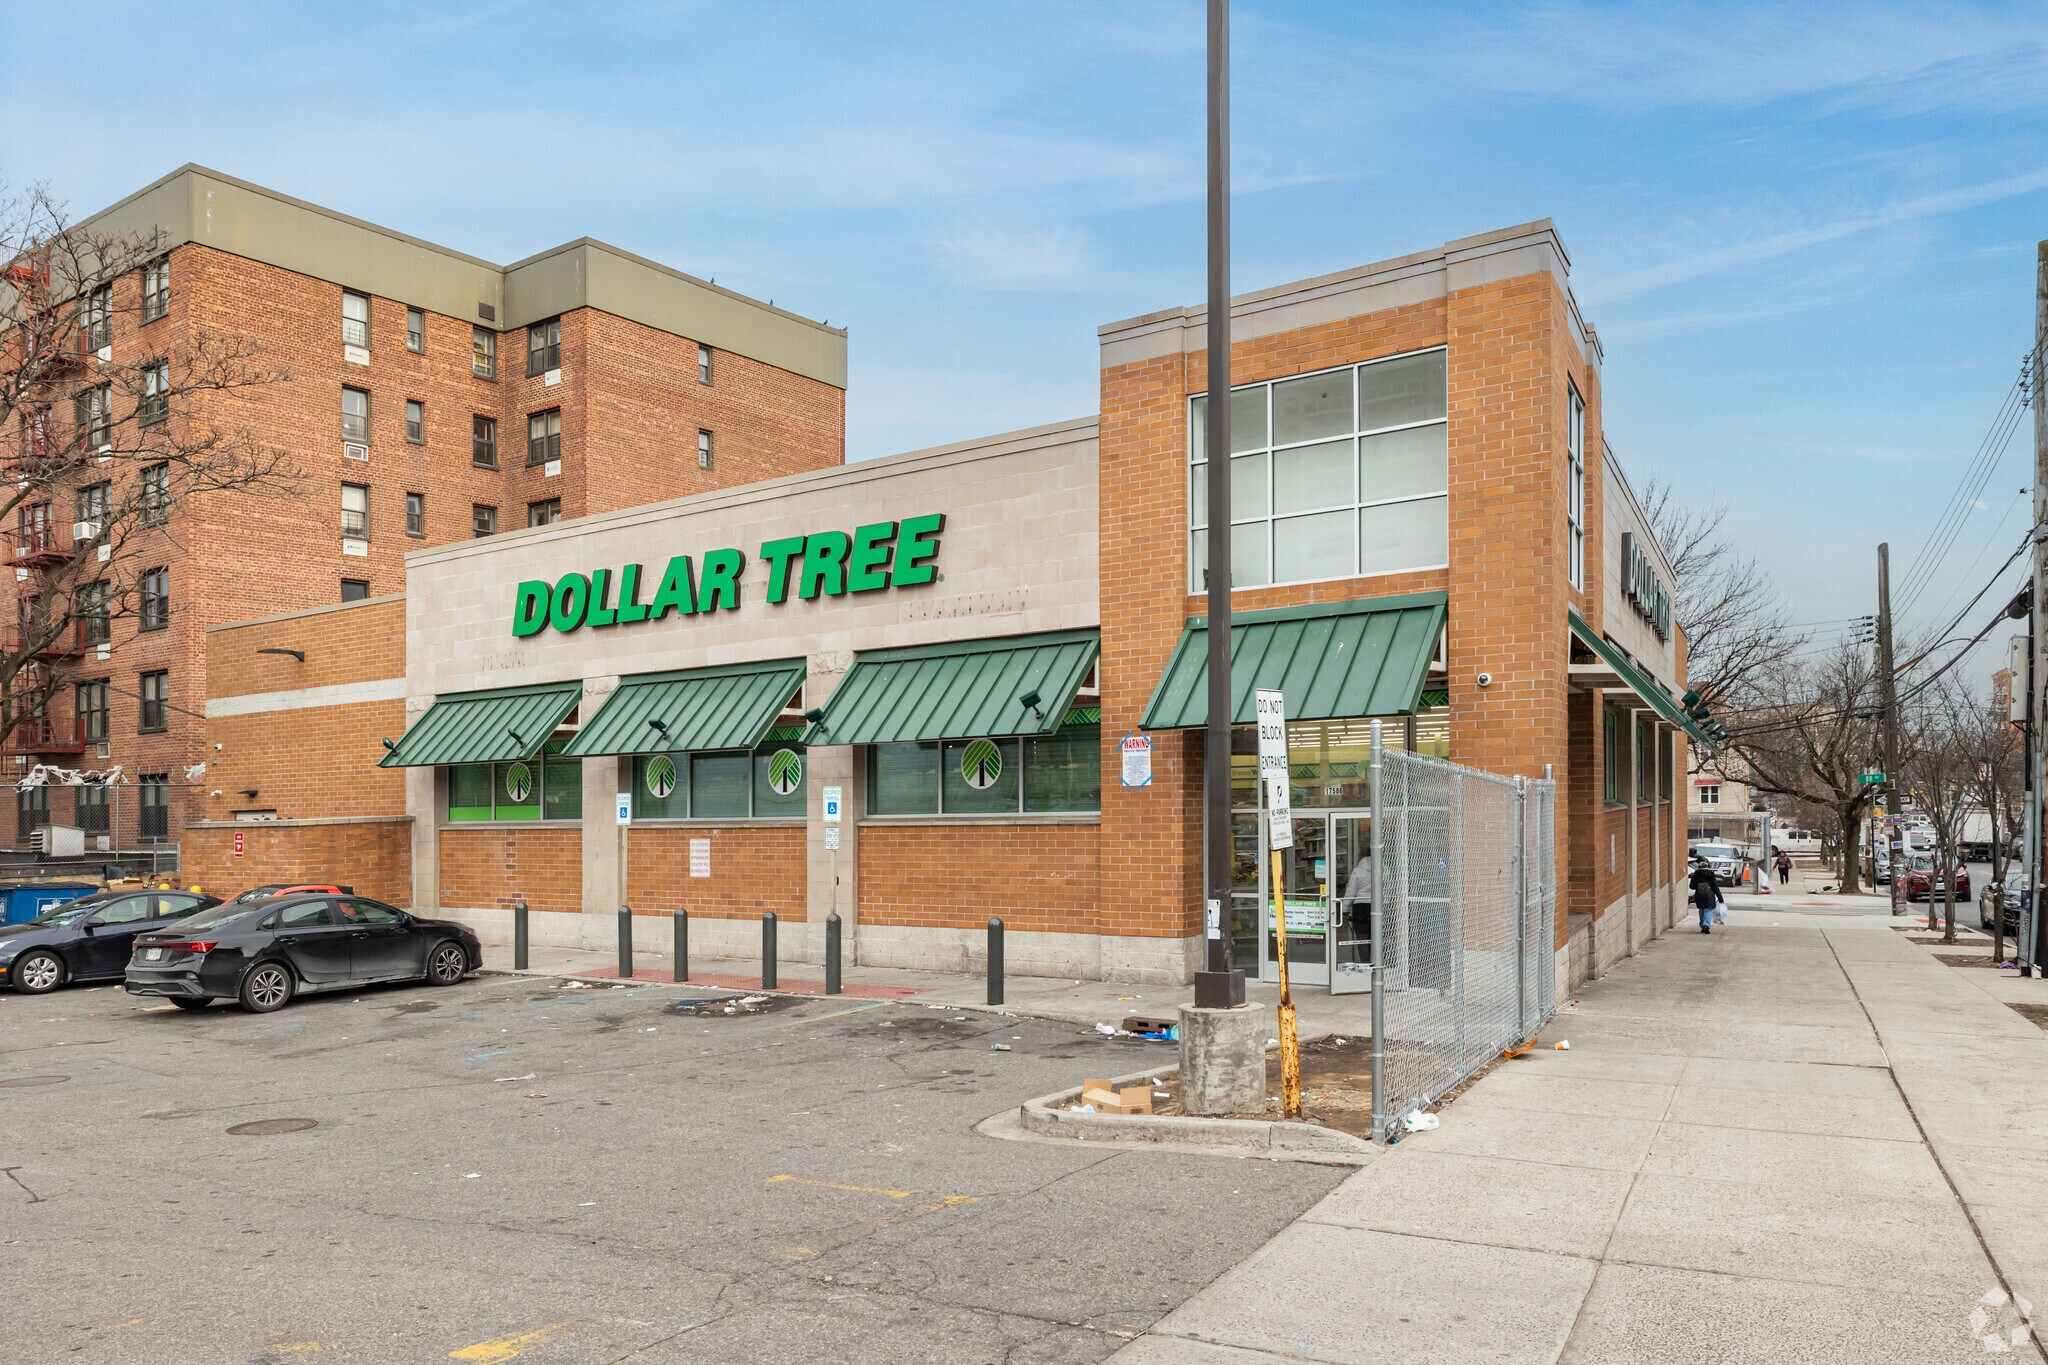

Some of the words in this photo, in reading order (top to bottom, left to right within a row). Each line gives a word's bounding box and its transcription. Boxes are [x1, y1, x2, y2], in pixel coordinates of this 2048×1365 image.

[512, 548, 745, 637] DOLLAR
[760, 513, 946, 604] TREE
[1258, 699, 1267, 713] DO
[1270, 700, 1282, 713] NOT
[1262, 726, 1283, 739] BLOCK
[1124, 739, 1149, 749] WARNING
[1262, 756, 1287, 769] ENTRANCE
[1326, 787, 1344, 795] 17506
